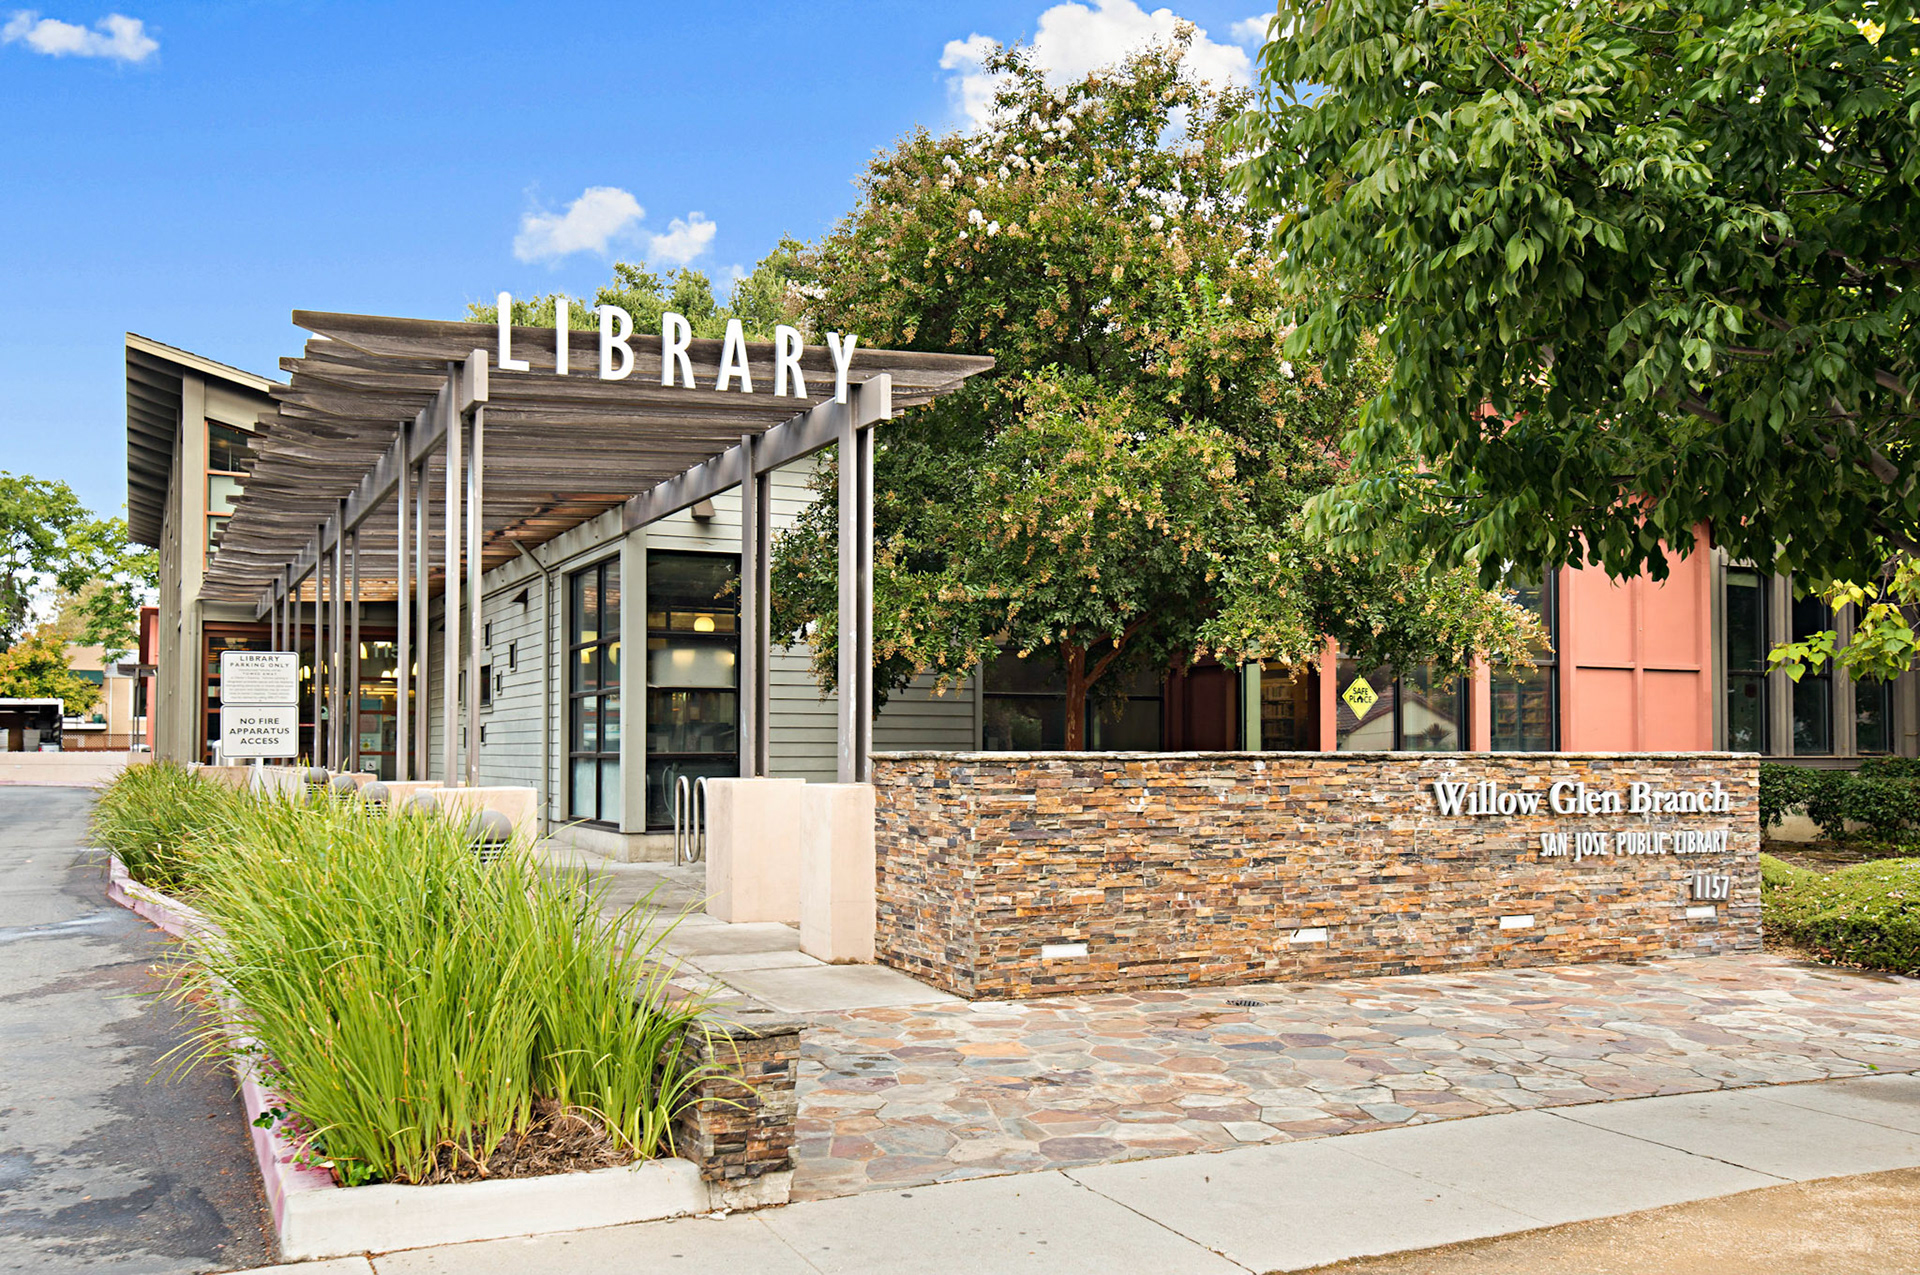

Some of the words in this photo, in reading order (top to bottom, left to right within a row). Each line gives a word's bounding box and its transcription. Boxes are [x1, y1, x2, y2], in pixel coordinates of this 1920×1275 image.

[497, 291, 858, 405] LIBRARY
[1352, 687, 1368, 695] SAFE
[1432, 780, 1542, 816] Willow
[1550, 780, 1621, 815] Glen
[1628, 780, 1730, 815] Branch
[1539, 832, 1568, 857] SAN
[1574, 832, 1609, 863] JOSE
[1616, 831, 1671, 855] PUBLIC
[1674, 830, 1729, 854] LIBRARY
[1695, 875, 1730, 899] 1157
